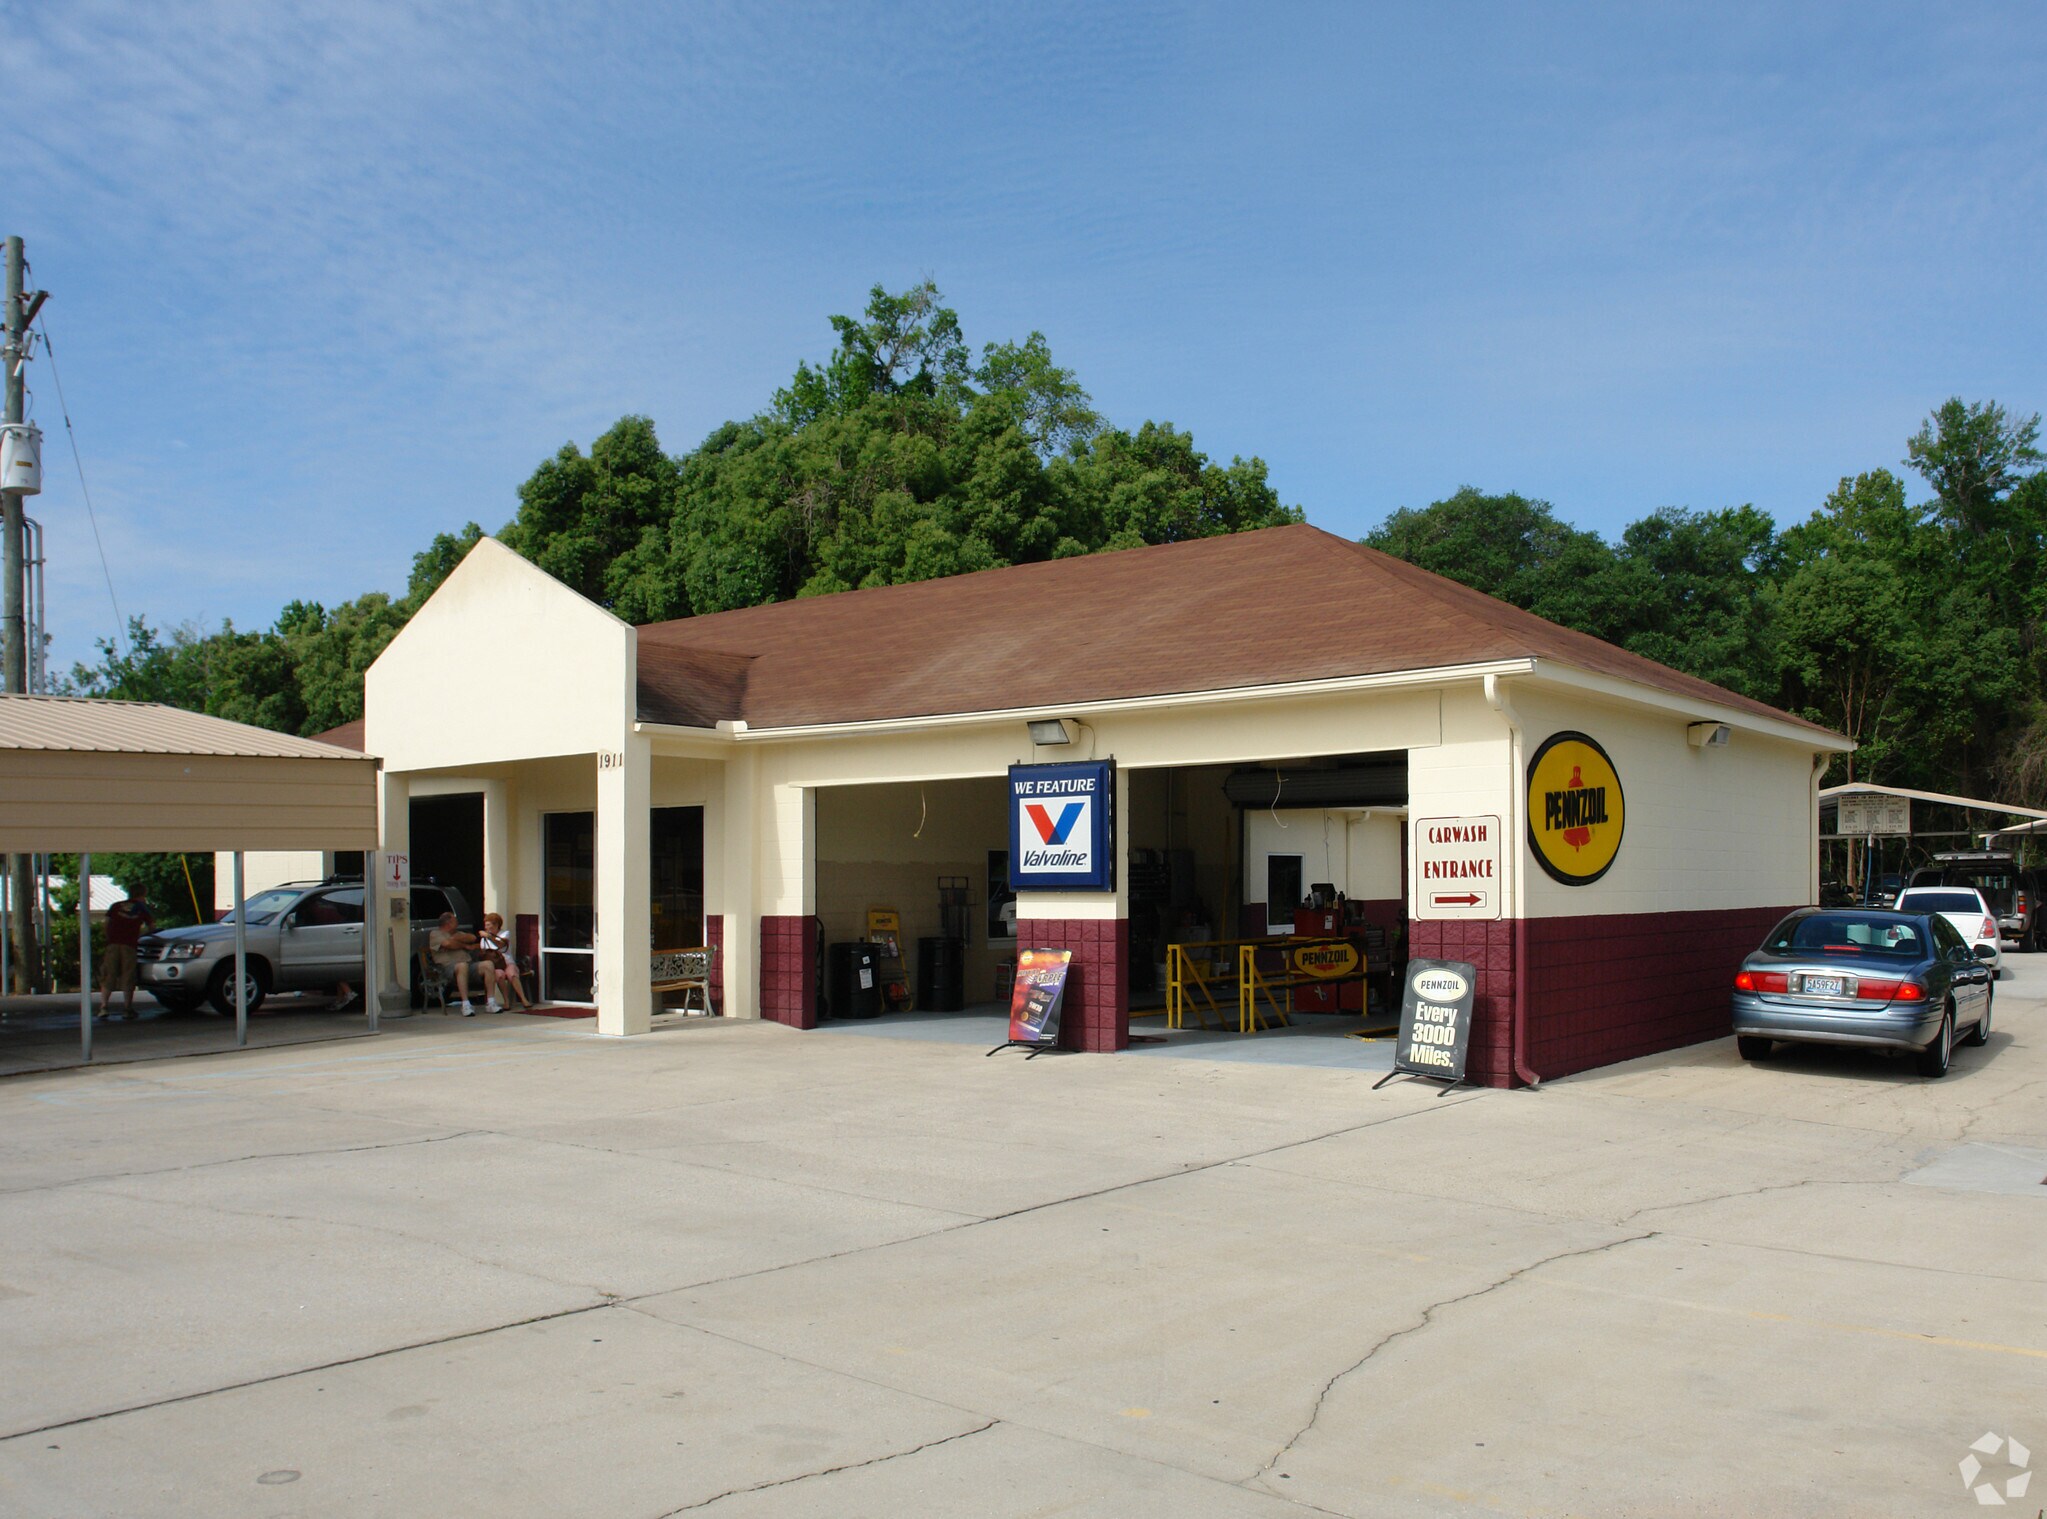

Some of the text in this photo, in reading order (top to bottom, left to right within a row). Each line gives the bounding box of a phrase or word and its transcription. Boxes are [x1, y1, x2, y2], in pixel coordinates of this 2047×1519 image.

[600, 752, 623, 769] 1911
[1014, 778, 1096, 795] WE FEATURE
[1545, 787, 1608, 831] PENNZOIL
[1428, 825, 1487, 844] CARWASH
[1023, 849, 1087, 867] Valvoline
[1424, 859, 1493, 879] ENTRANCE
[1302, 949, 1350, 966] PENNZOIL
[1420, 980, 1460, 990] PENNZOIL
[1415, 1001, 1458, 1026] Every
[1412, 1022, 1455, 1047] 3000
[1409, 1043, 1454, 1068] Miles.
